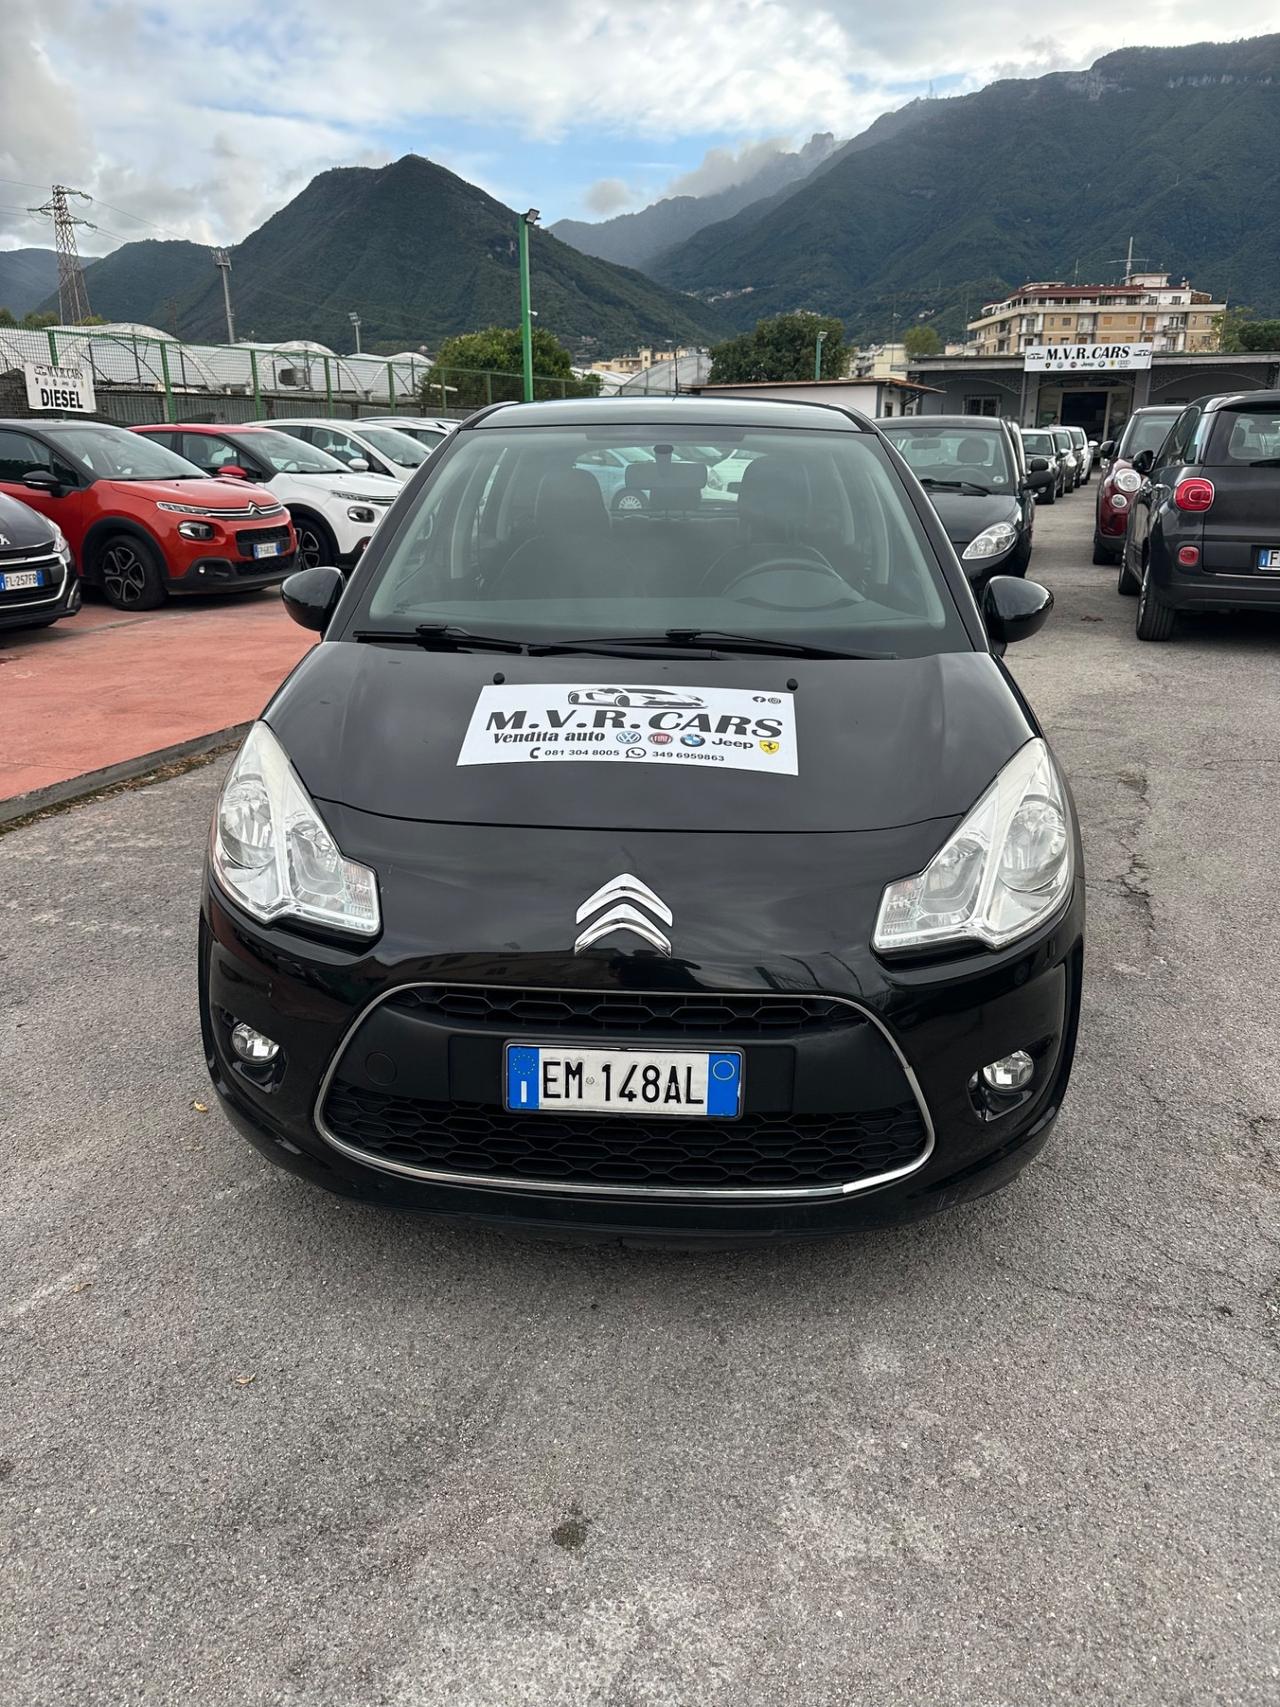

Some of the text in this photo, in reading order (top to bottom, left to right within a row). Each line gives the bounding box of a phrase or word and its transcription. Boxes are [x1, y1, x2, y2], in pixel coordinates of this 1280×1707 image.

[40, 387, 84, 409] DIESEL
[493, 731, 606, 744] Vendita auto
[711, 737, 754, 750] Jeep
[652, 750, 725, 762] 349 6959863
